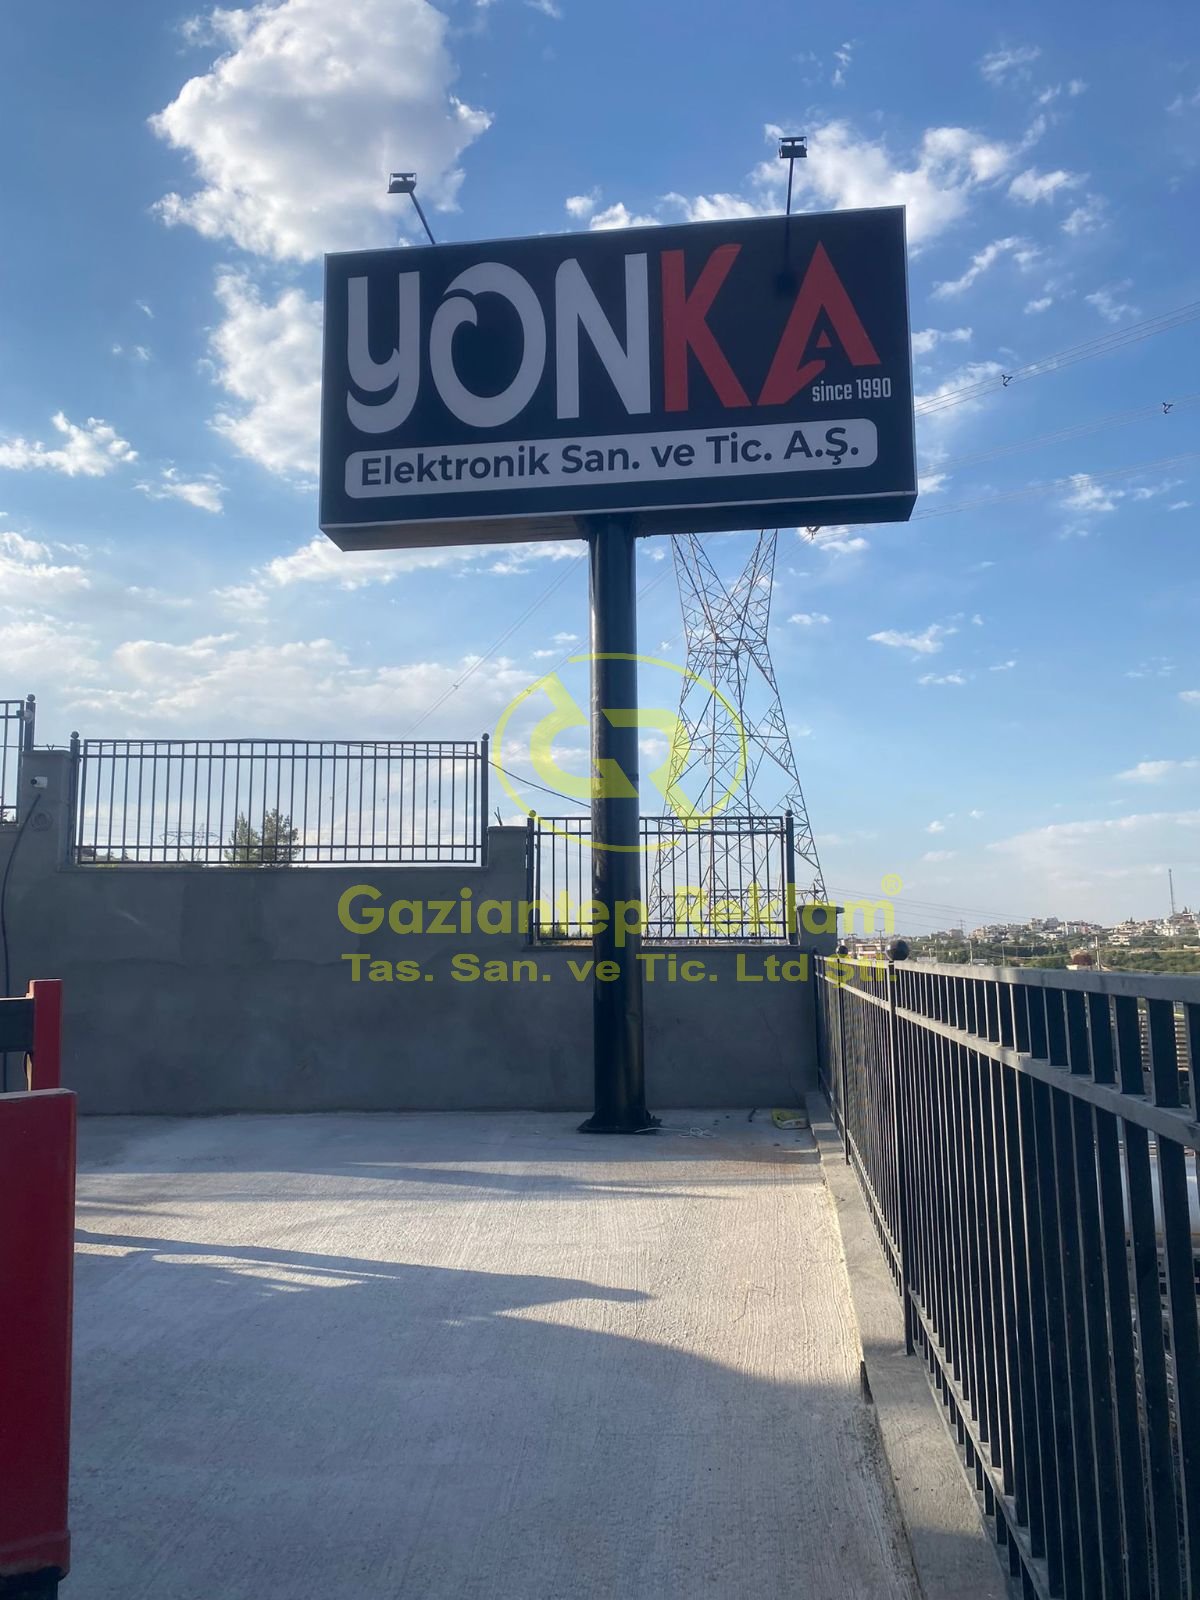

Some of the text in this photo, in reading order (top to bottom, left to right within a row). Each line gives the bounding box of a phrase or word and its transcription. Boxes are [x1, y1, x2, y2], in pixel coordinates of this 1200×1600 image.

[811, 377, 892, 402] since 1990
[360, 426, 860, 487] Elektronik San. ve Tic. A.Ş.
